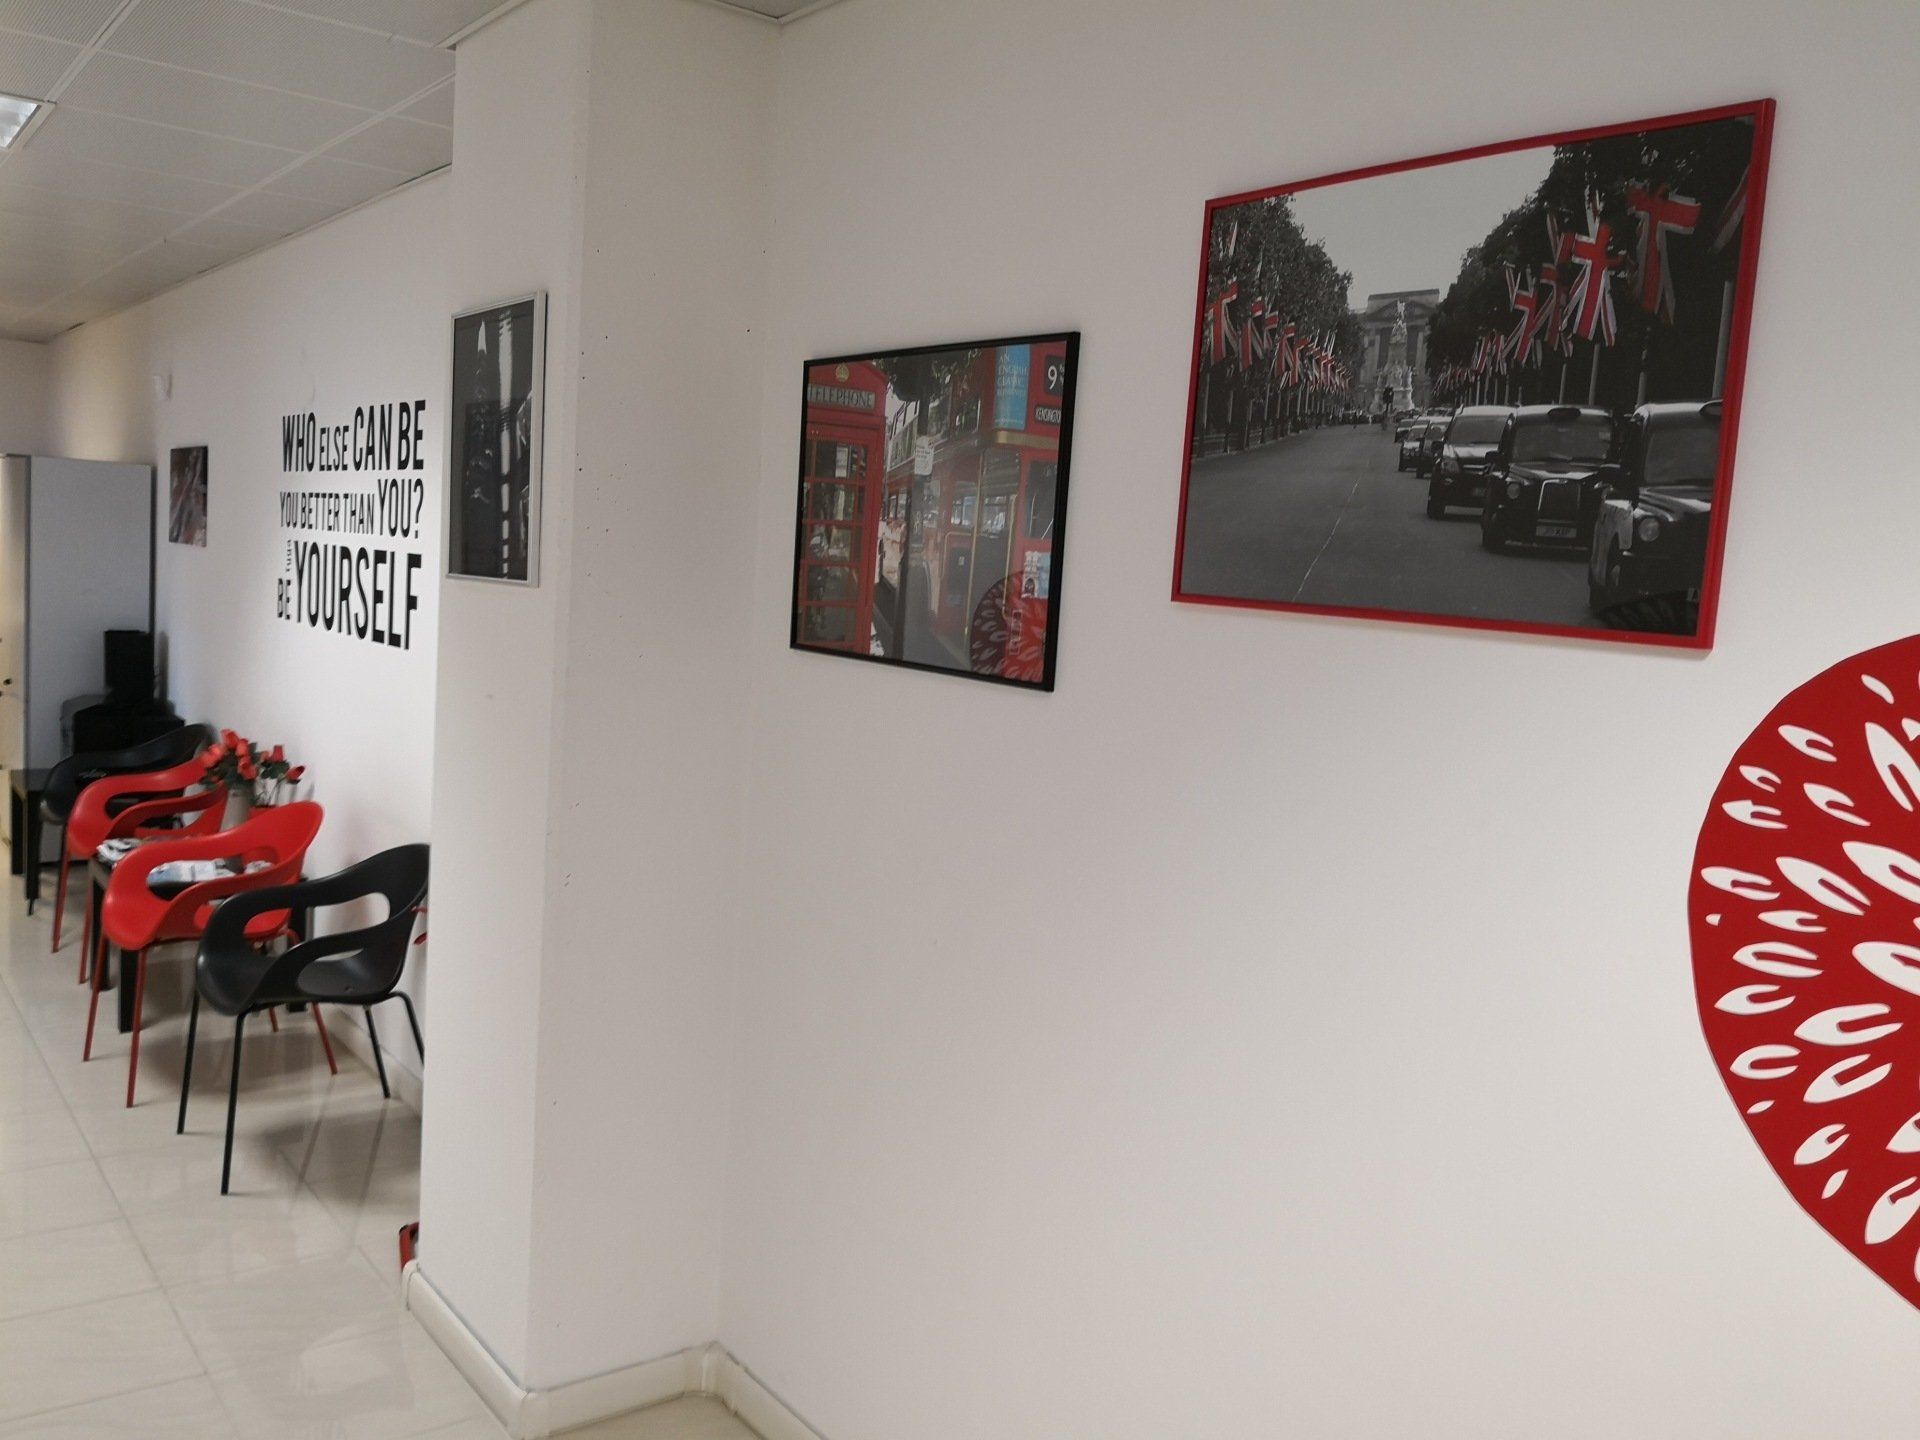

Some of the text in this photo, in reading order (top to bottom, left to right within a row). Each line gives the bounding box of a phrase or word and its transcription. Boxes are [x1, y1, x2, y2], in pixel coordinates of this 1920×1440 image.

[1047, 365, 1057, 390] 9
[282, 399, 426, 472] WHO ELSE CAN BE
[280, 478, 424, 539] YOU BETTER THAN YOU?
[277, 577, 291, 620] BE
[294, 539, 422, 650] YOURSELF
